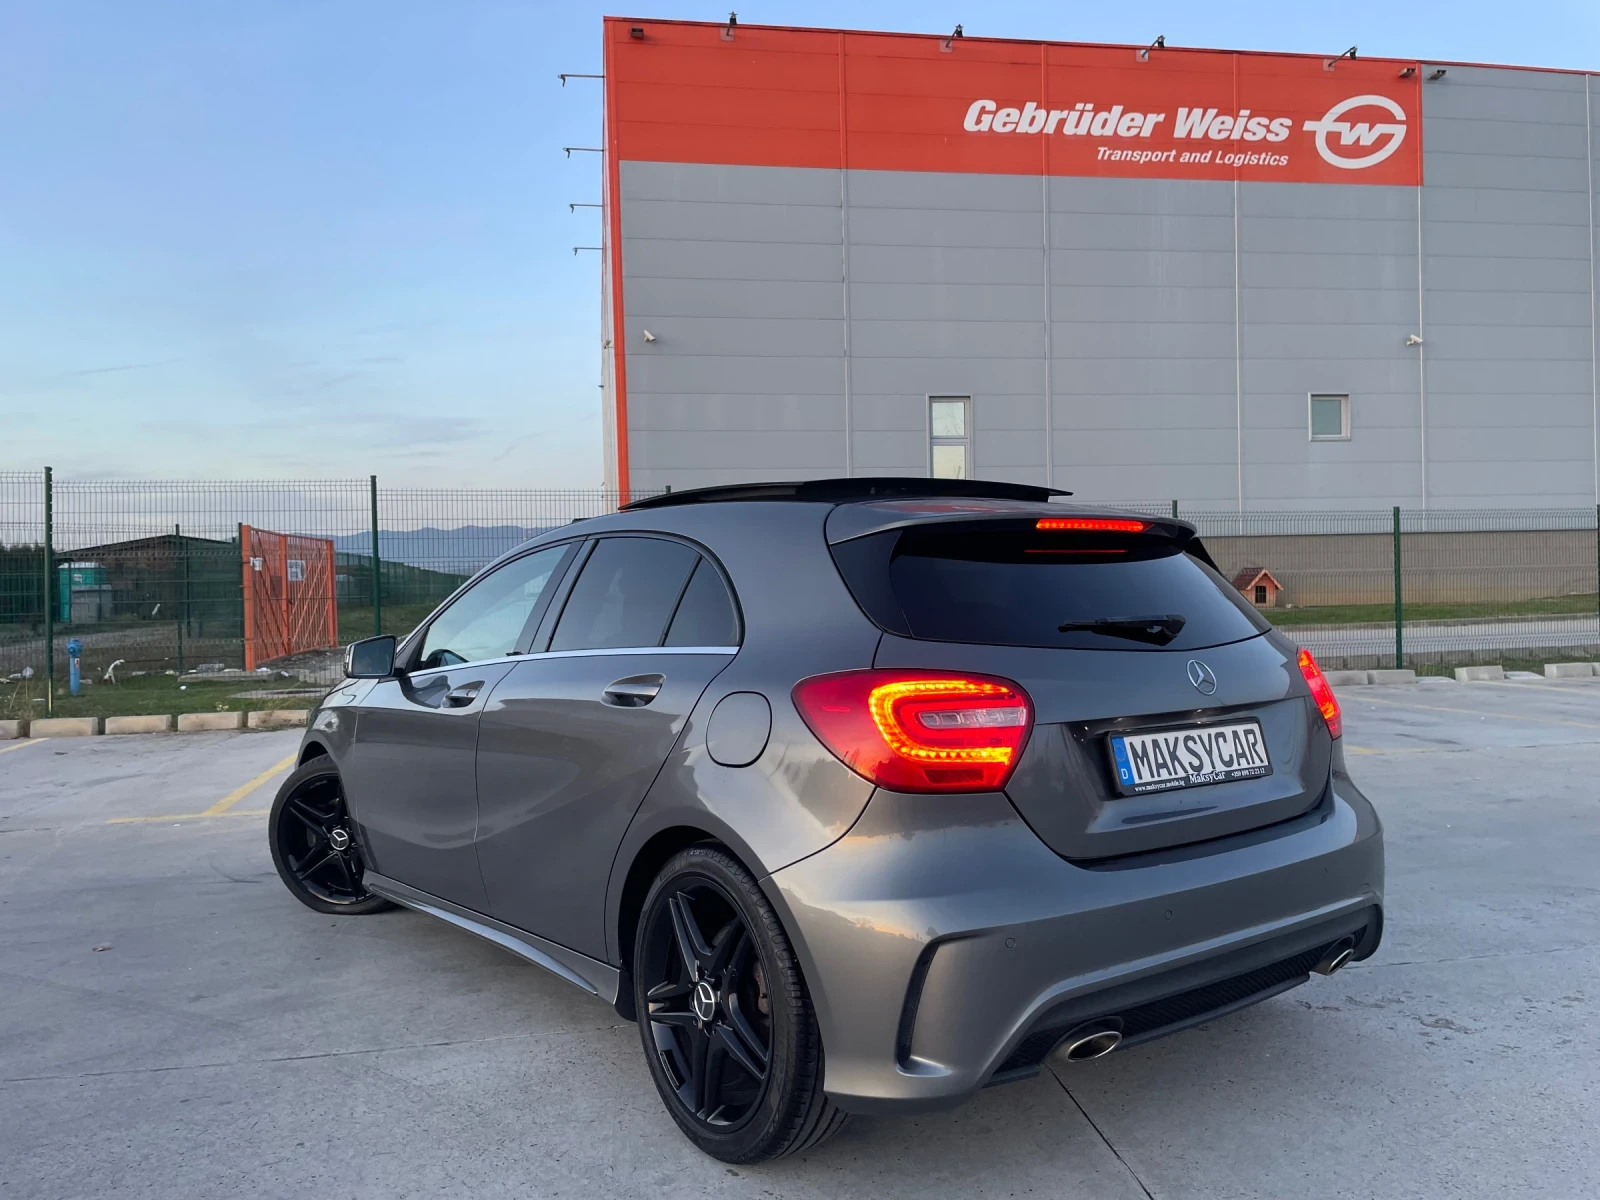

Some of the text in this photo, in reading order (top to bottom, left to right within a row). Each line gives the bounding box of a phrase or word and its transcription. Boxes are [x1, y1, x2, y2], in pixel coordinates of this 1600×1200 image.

[963, 99, 1292, 143] Gebrüder Weiss
[1096, 146, 1289, 168] Transport and Logistics
[1129, 728, 1264, 779] MAKSYCAR
[1121, 768, 1128, 780] D
[1188, 771, 1226, 783] MaksyCar
